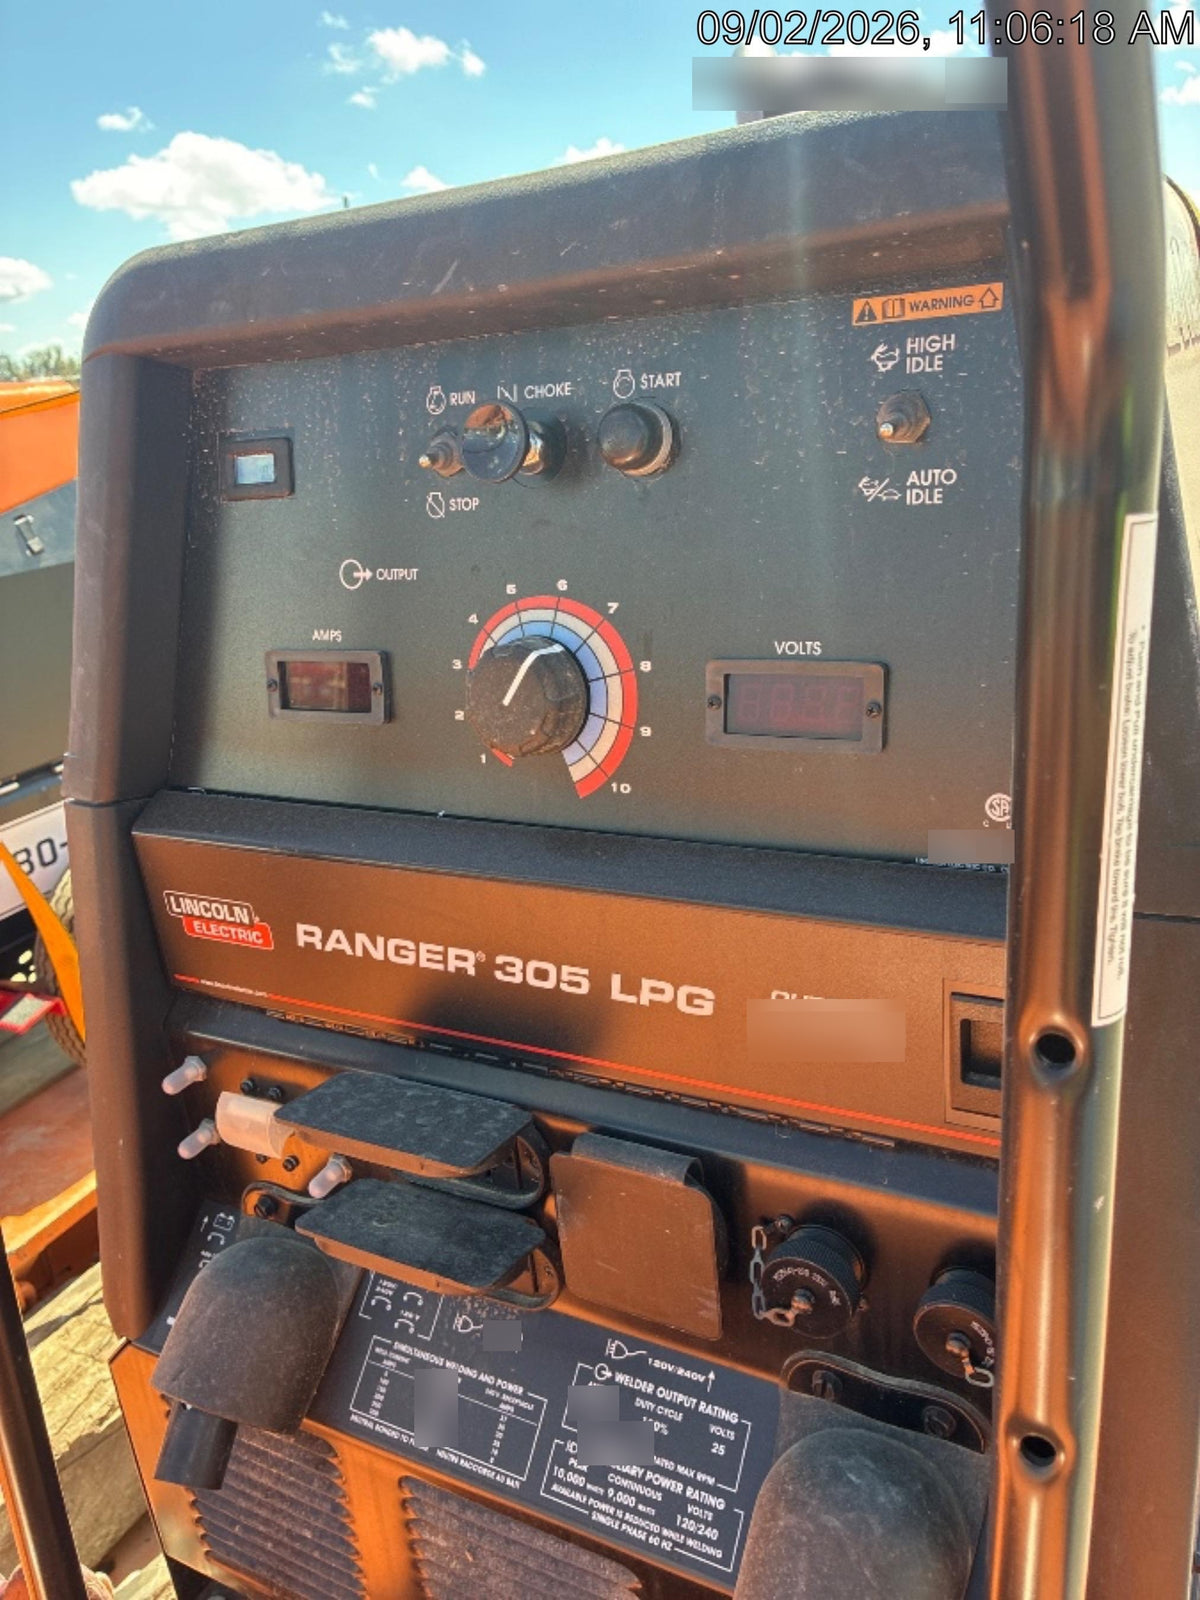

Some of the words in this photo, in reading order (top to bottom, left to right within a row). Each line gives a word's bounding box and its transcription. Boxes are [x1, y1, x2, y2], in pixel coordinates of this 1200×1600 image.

[909, 294, 975, 313] WARNING
[906, 334, 956, 355] HIGH
[906, 355, 944, 374] IDLE
[639, 372, 681, 389] START
[449, 391, 476, 406] RUN
[524, 383, 572, 400] CHOKE
[906, 468, 958, 487] AUTO
[449, 498, 480, 511] STOP
[906, 488, 944, 505] IDLE
[376, 568, 420, 581] OUTPUT
[505, 583, 518, 596] 5
[556, 579, 569, 592] 6
[607, 601, 620, 615] 7
[468, 612, 480, 624] 4
[312, 629, 343, 643] AMPS
[774, 640, 823, 656] VOLTS
[452, 658, 464, 670] 3
[640, 660, 653, 673] 8
[454, 709, 466, 721] 2
[640, 725, 653, 738] 9
[480, 753, 488, 765] 1
[611, 781, 632, 795] 10
[169, 896, 251, 926] LINCOLN
[193, 920, 264, 945] ELECTRIC
[494, 955, 590, 996] 305
[611, 973, 716, 1017] LPG
[478, 1372, 496, 1385] AND
[496, 1378, 524, 1396] POWER
[615, 1371, 655, 1396] WELDER
[655, 1386, 699, 1411] OUTPUT
[698, 1400, 740, 1425] RATING
[634, 1397, 656, 1412] DUTY
[656, 1406, 684, 1422] CYCLE
[709, 1424, 735, 1441] VOLTS
[710, 1442, 726, 1455] 25
[676, 1464, 696, 1478] MAX
[608, 1473, 662, 1501] CONTINUOUS
[645, 1469, 684, 1495] POWER
[686, 1486, 726, 1510] RATING
[688, 1504, 714, 1522] VOLTS
[588, 1497, 617, 1516] POWER
[686, 1537, 723, 1558] WELDING
[620, 1522, 648, 1543] PHASE
[648, 1533, 661, 1546] 60
[677, 1514, 719, 1541] 120/240
